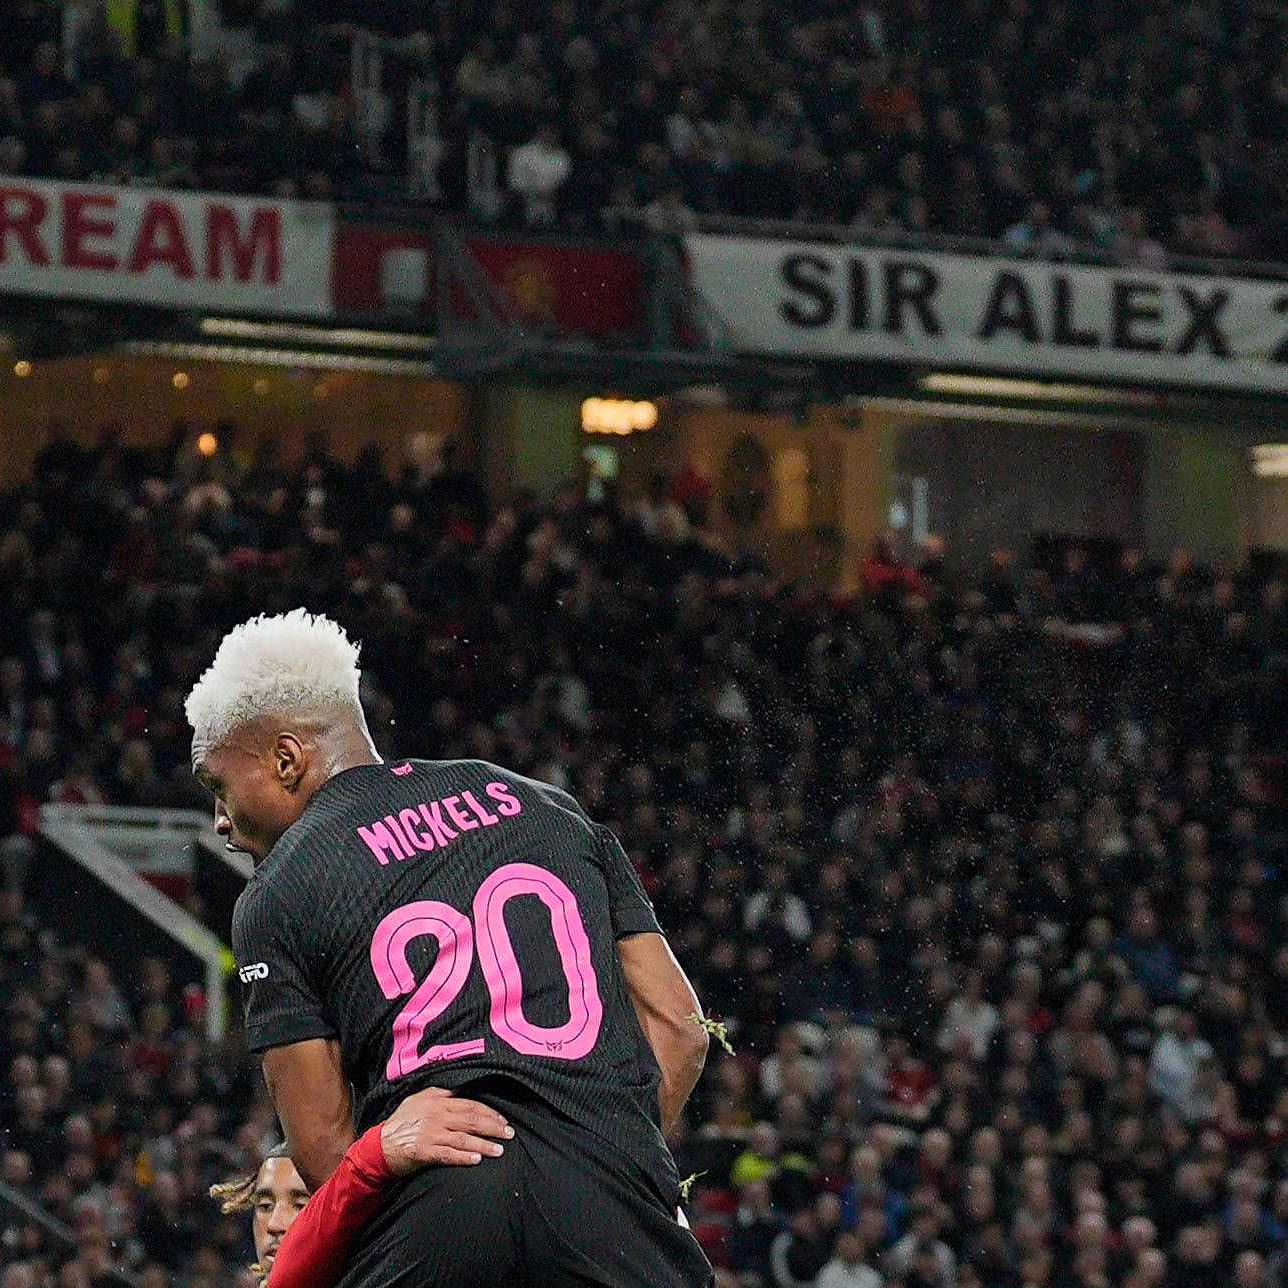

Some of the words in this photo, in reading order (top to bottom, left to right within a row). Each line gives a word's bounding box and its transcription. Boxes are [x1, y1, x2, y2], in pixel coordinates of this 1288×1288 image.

[778, 252, 944, 337] SIR
[979, 268, 1231, 360] ALEX
[357, 781, 523, 866] MICKELS
[369, 862, 603, 1081] 20
